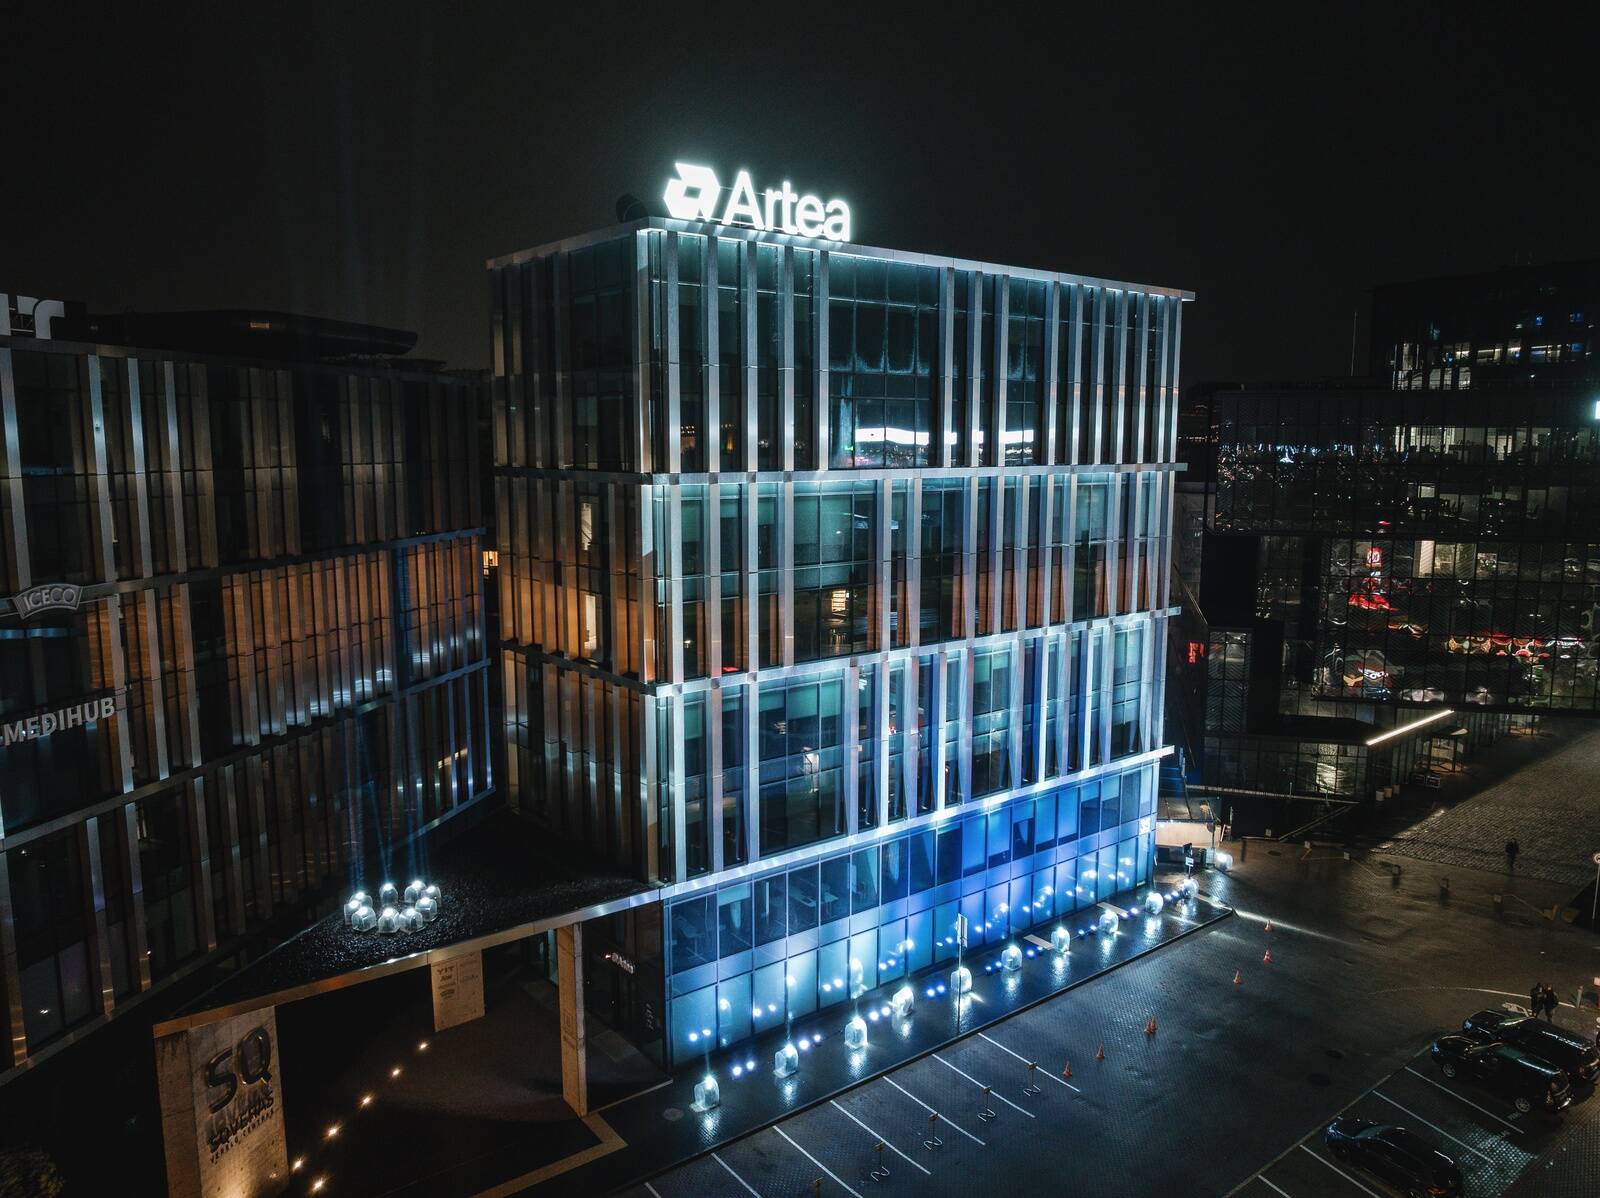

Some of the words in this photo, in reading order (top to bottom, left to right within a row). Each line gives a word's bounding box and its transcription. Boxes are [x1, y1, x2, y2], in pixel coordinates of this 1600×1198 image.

[722, 171, 850, 241] Artea
[23, 588, 76, 610] ICECO
[3, 698, 115, 746] MEDIHUB
[206, 1027, 272, 1114] SQ
